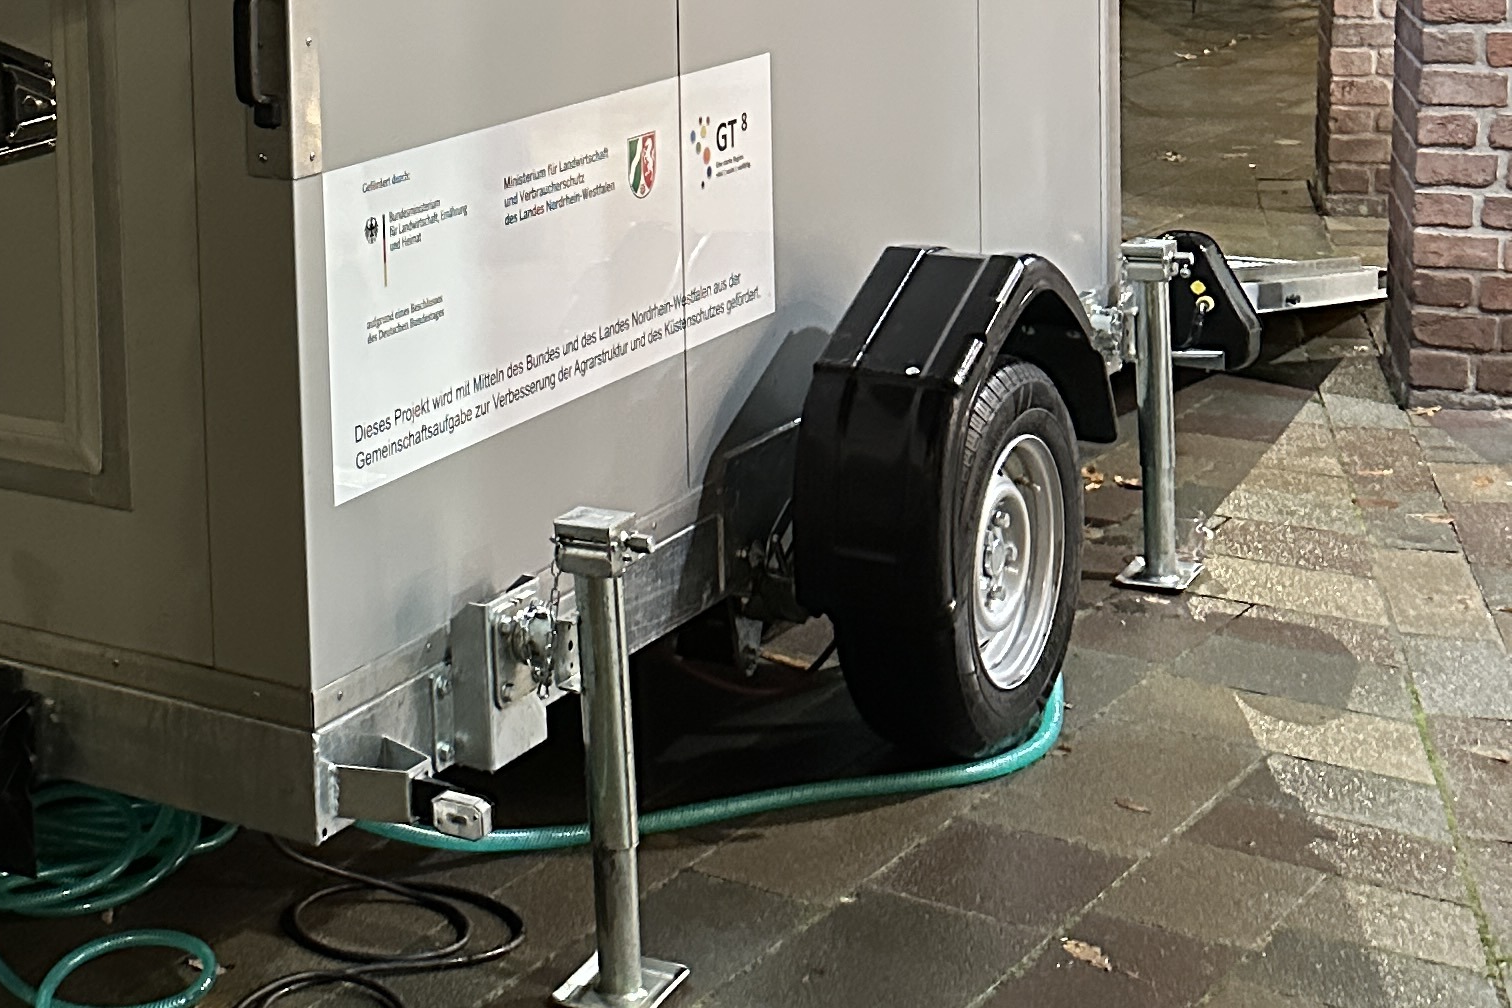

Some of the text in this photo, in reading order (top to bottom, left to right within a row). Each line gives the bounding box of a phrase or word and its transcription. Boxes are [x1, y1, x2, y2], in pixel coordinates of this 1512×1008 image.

[716, 119, 737, 151] GT
[504, 147, 609, 190] Ministerium für Landwirtschaft
[504, 173, 585, 208] und Verbraucherschutz
[504, 181, 615, 226] des Landes Nordrhein-Westfalen
[355, 272, 741, 443] Dieses Projekt wird mit Mitteln des Bundes und des Landes Nordrhein-Westfalen aus der
[355, 286, 761, 469] Gemeinschaftsaufgabe zur Verbesserung der Agrarstruktur und des Küstenschutzes gefördert.
